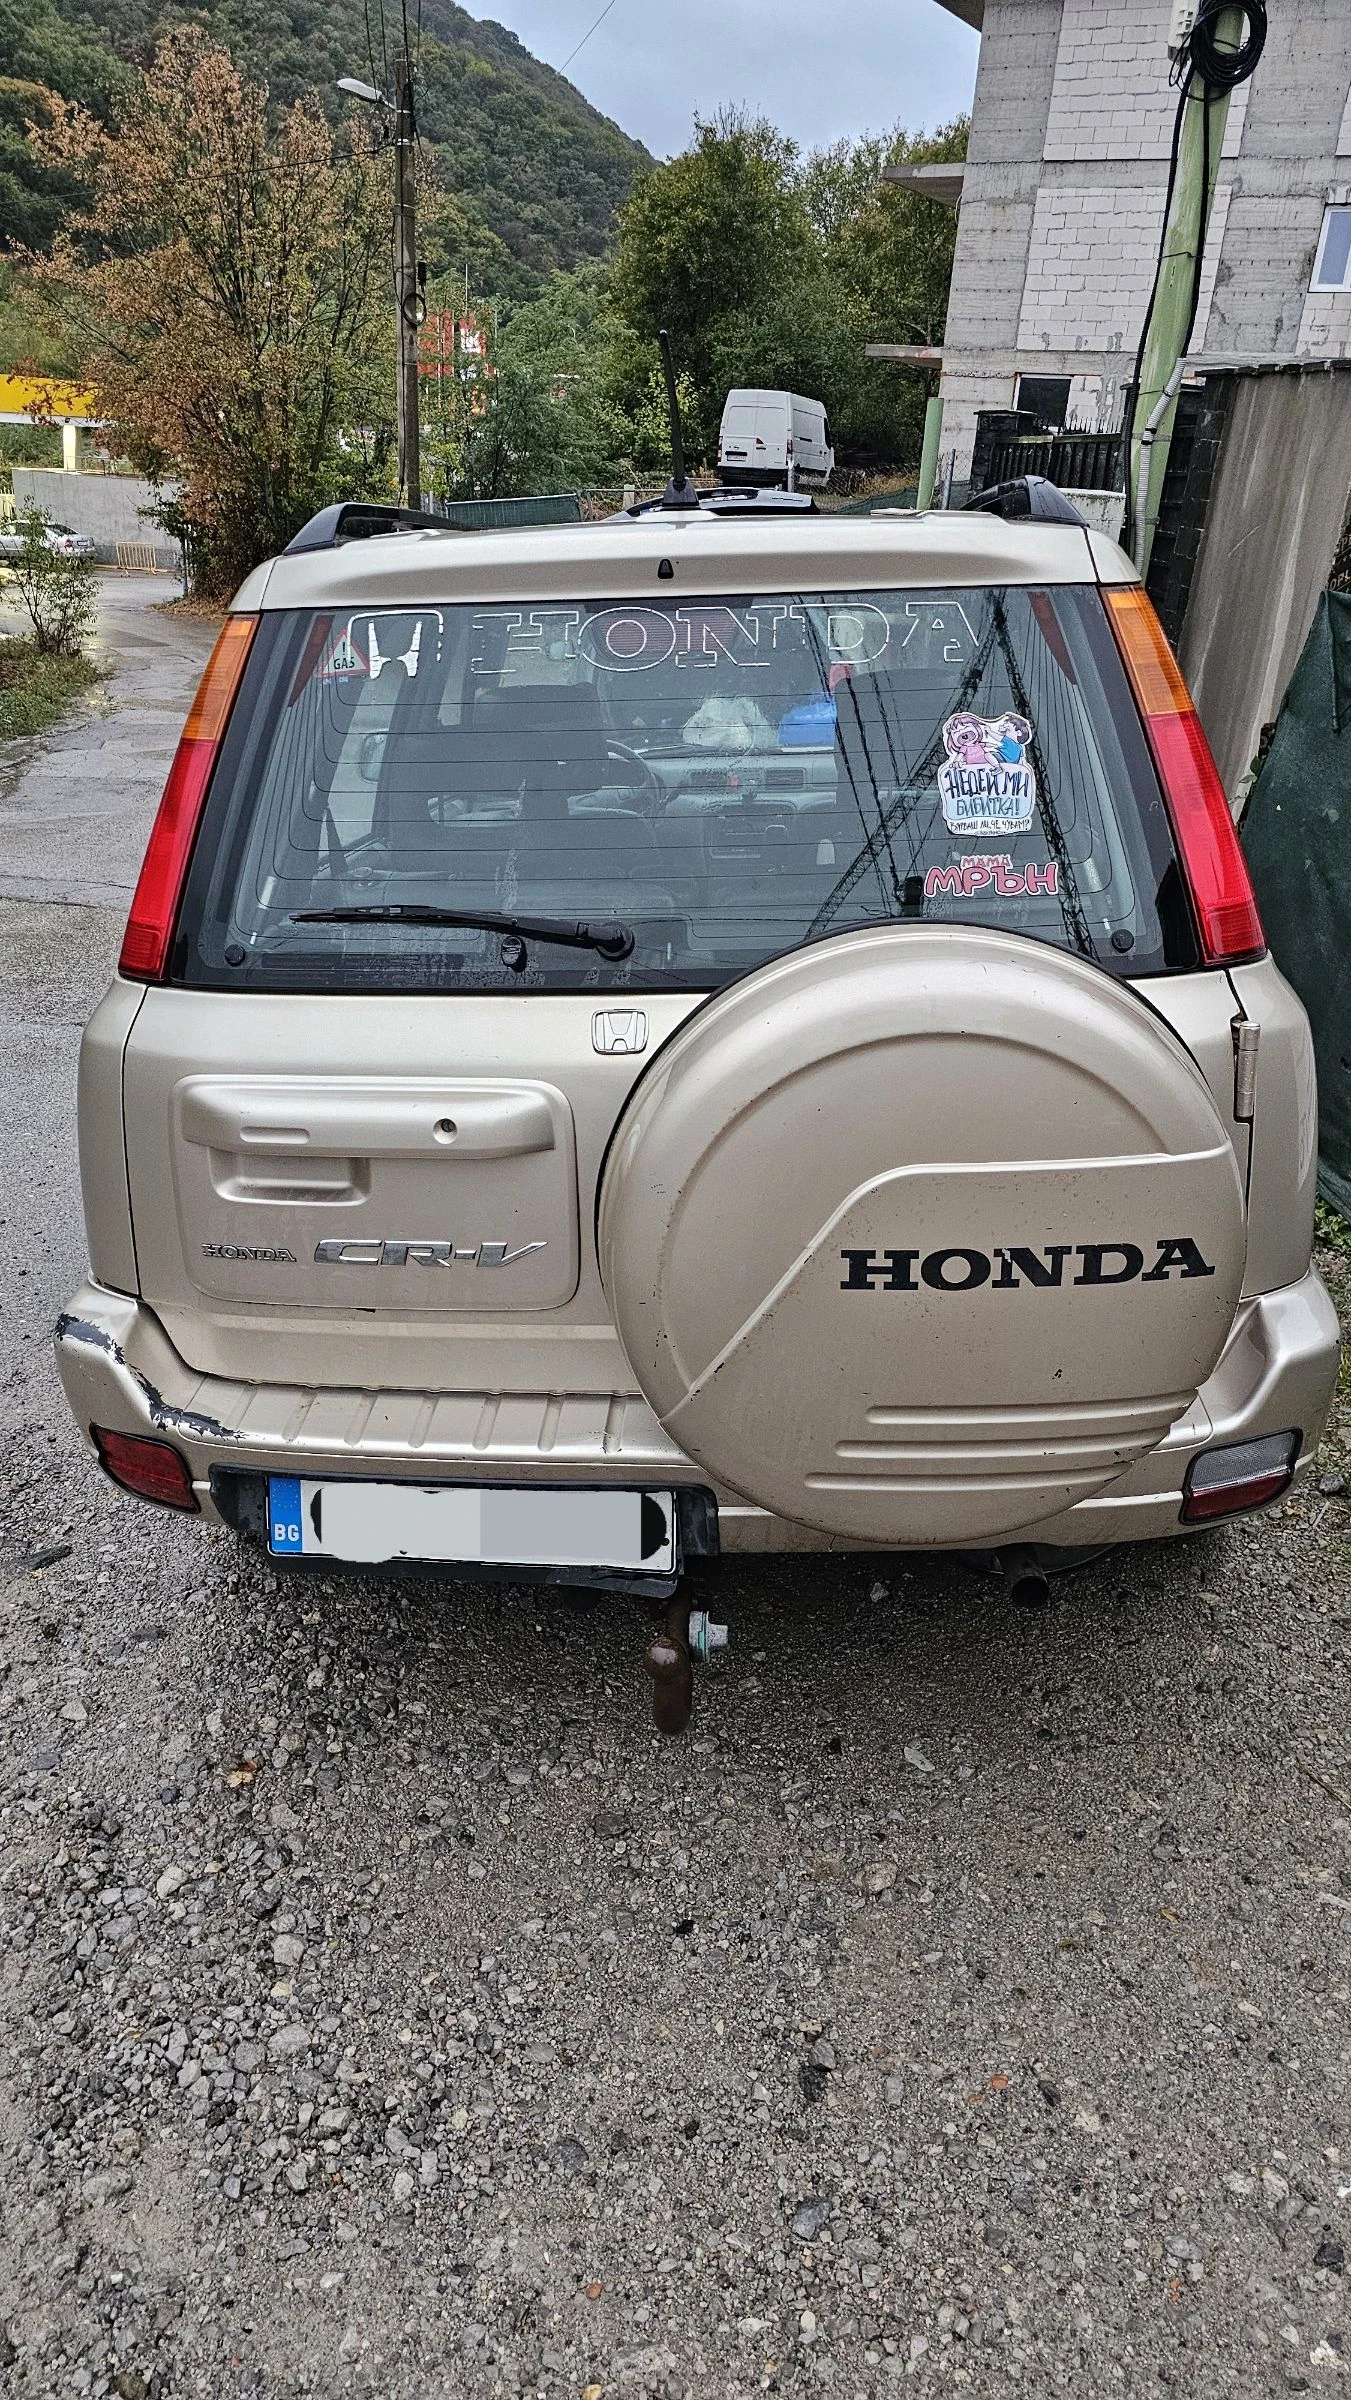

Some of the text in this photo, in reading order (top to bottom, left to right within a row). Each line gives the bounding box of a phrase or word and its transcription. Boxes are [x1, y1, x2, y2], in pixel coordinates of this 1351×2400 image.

[472, 601, 980, 673] HONDA
[333, 656, 356, 670] GAS
[1002, 770, 1030, 798] МИ
[925, 863, 1058, 896] МРЪН
[201, 1238, 549, 1268] HONDA CR-V
[840, 1237, 1216, 1291] HONDA
[274, 1523, 300, 1542] BG
